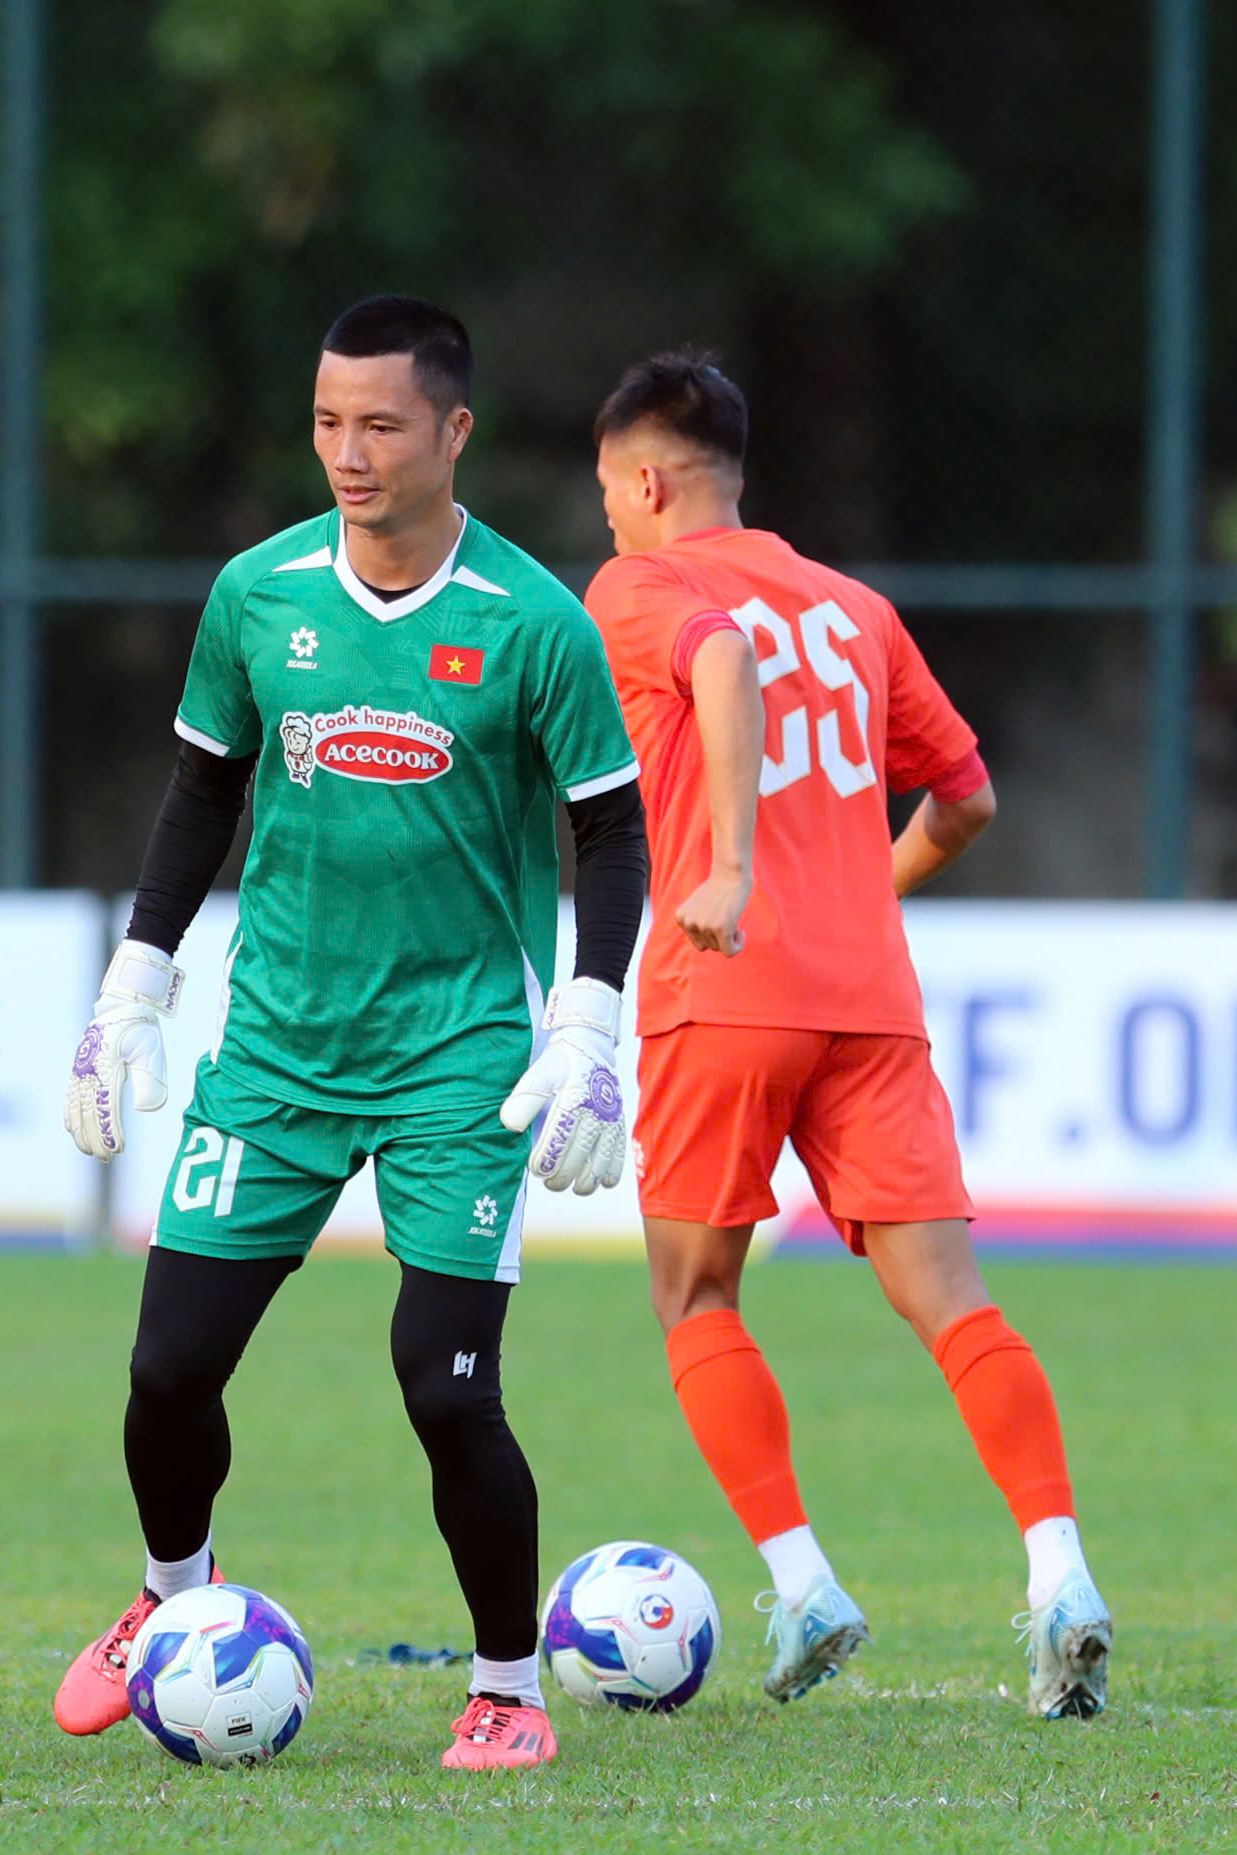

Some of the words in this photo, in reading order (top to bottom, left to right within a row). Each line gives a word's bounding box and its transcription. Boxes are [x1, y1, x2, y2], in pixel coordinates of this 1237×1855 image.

[315, 710, 359, 732] Cook
[364, 711, 451, 745] happiness
[728, 596, 877, 798] 25
[172, 1126, 245, 1217] 21
